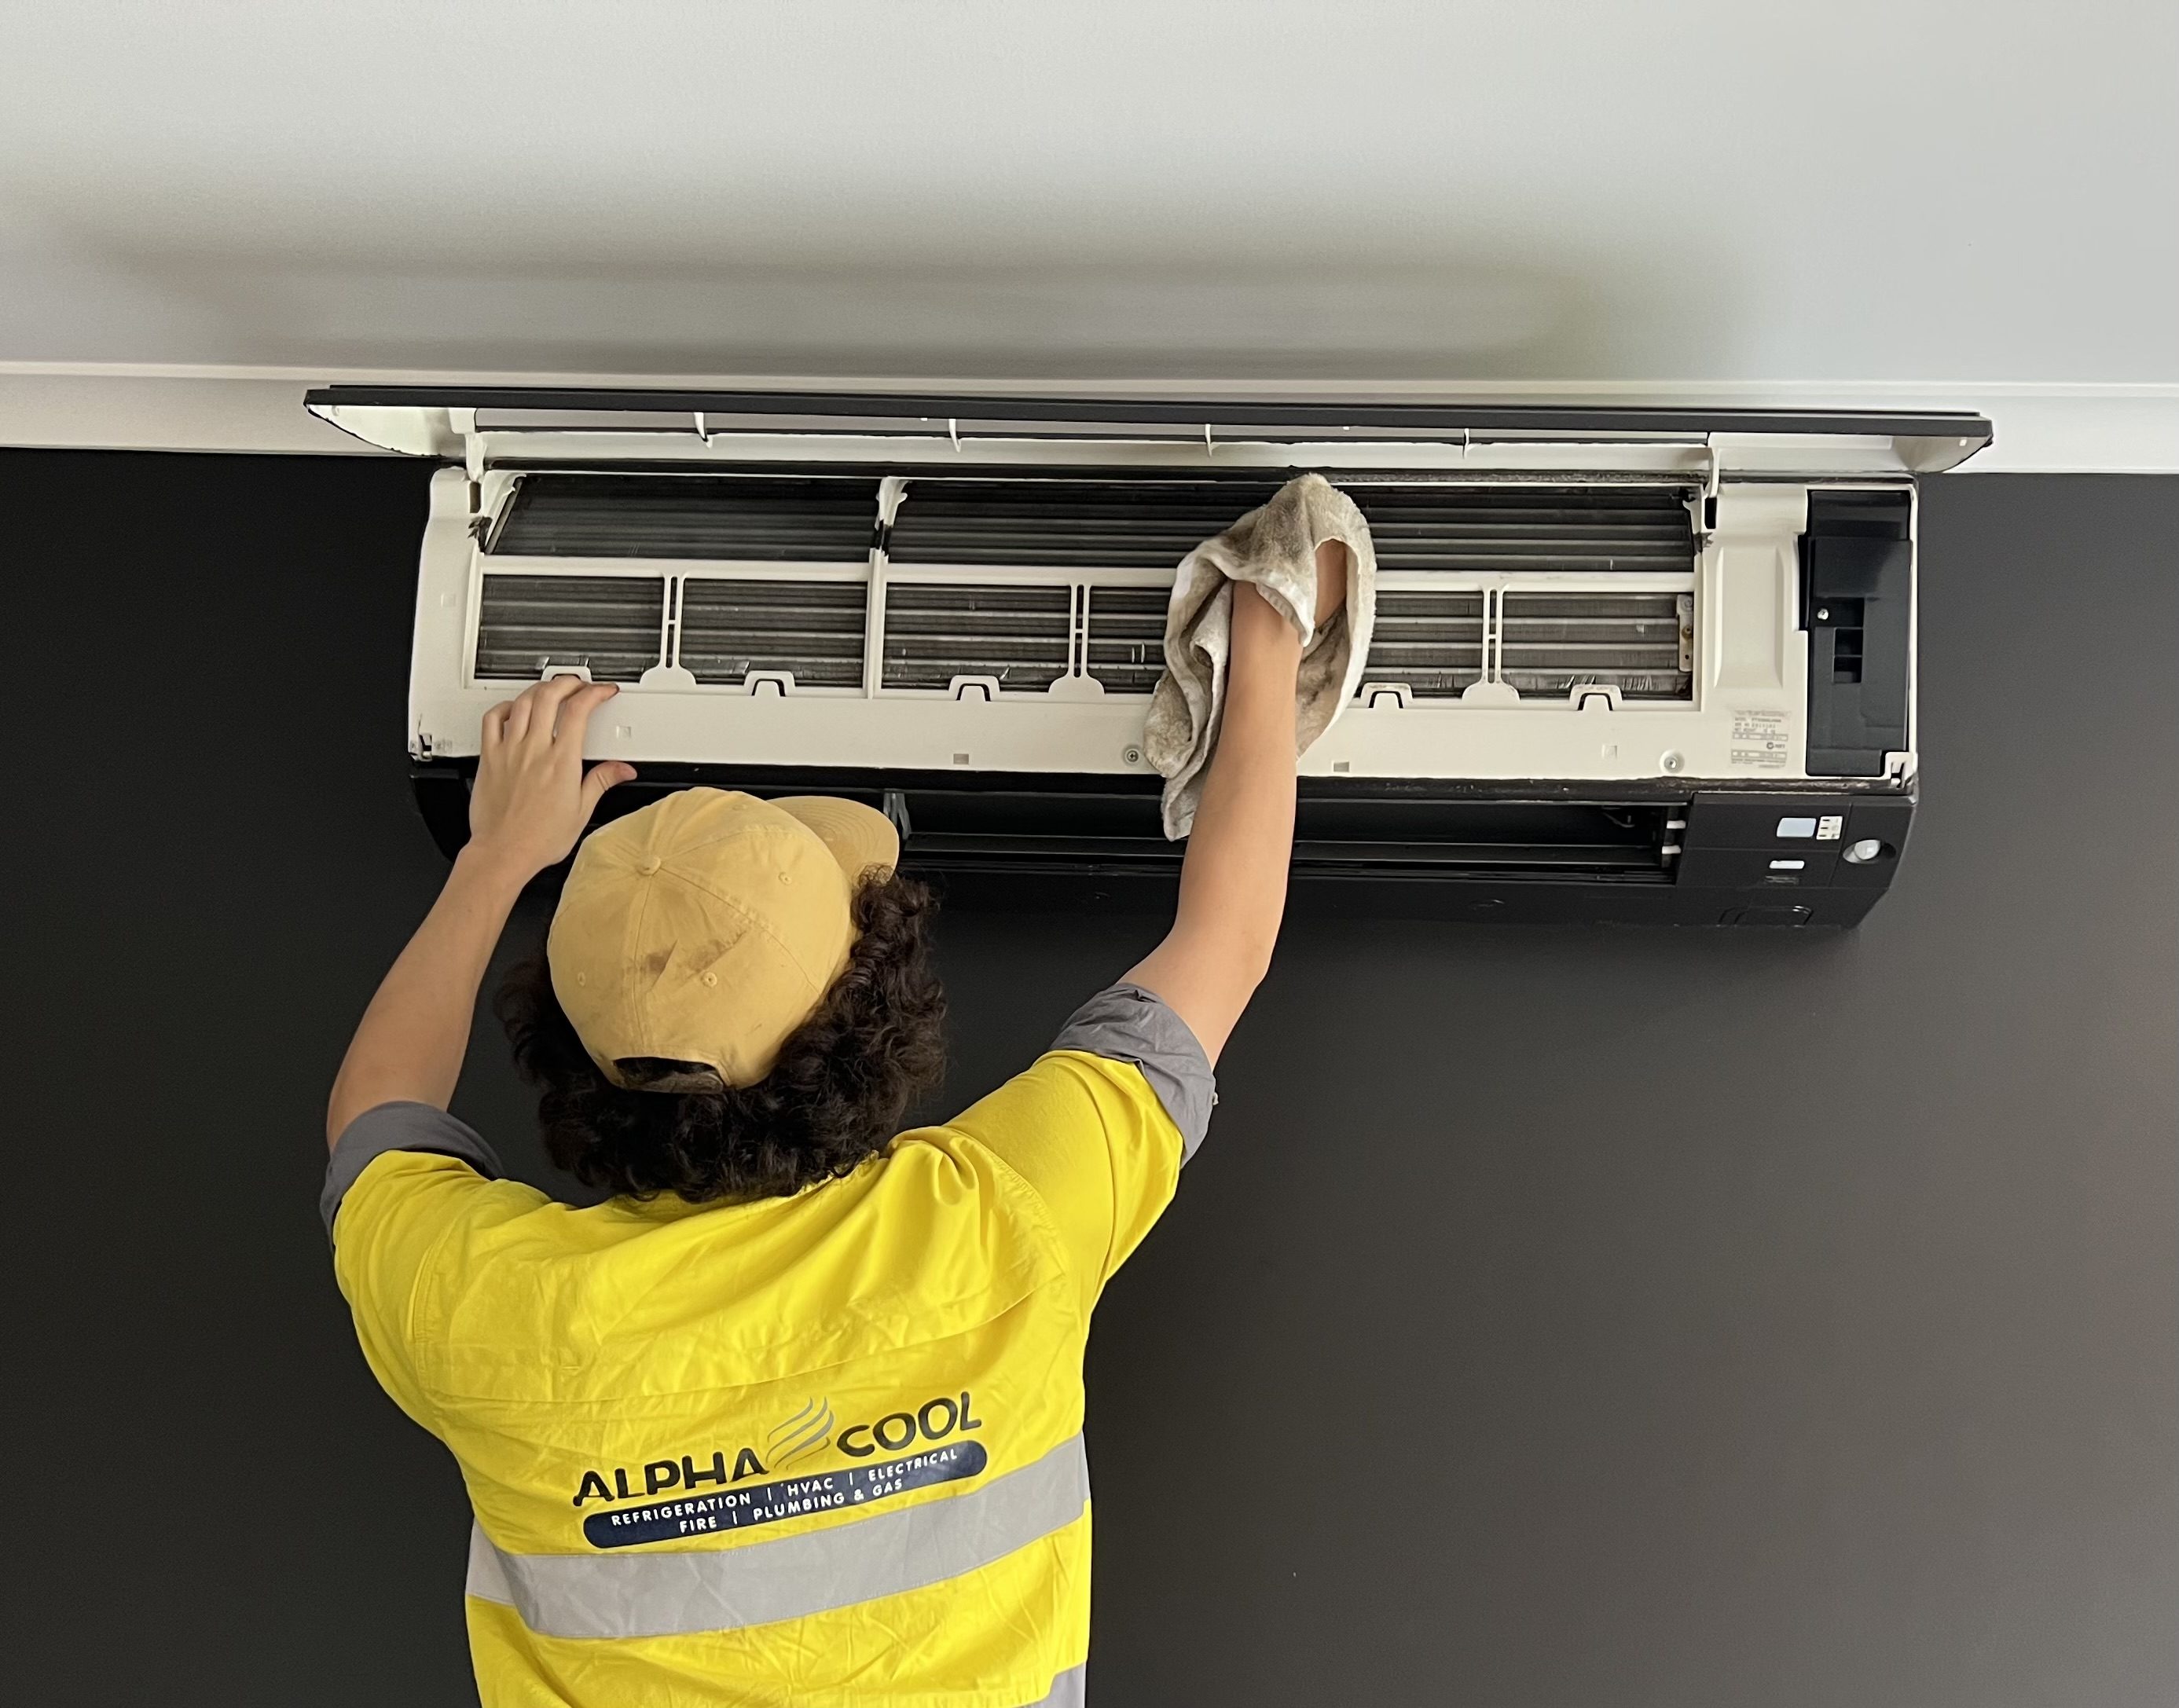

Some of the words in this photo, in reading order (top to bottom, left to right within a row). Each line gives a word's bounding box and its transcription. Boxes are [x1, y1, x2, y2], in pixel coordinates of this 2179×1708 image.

[573, 1448, 769, 1506] ALPHA
[837, 1391, 981, 1457] COOL
[611, 1493, 751, 1526] REFRIGERATION
[787, 1477, 834, 1496] HVAC
[868, 1449, 957, 1481] ELECTRICAL
[680, 1516, 717, 1534] FIRE
[754, 1494, 845, 1521] PLUMBING
[854, 1489, 864, 1501] &
[873, 1479, 903, 1497] GAS
